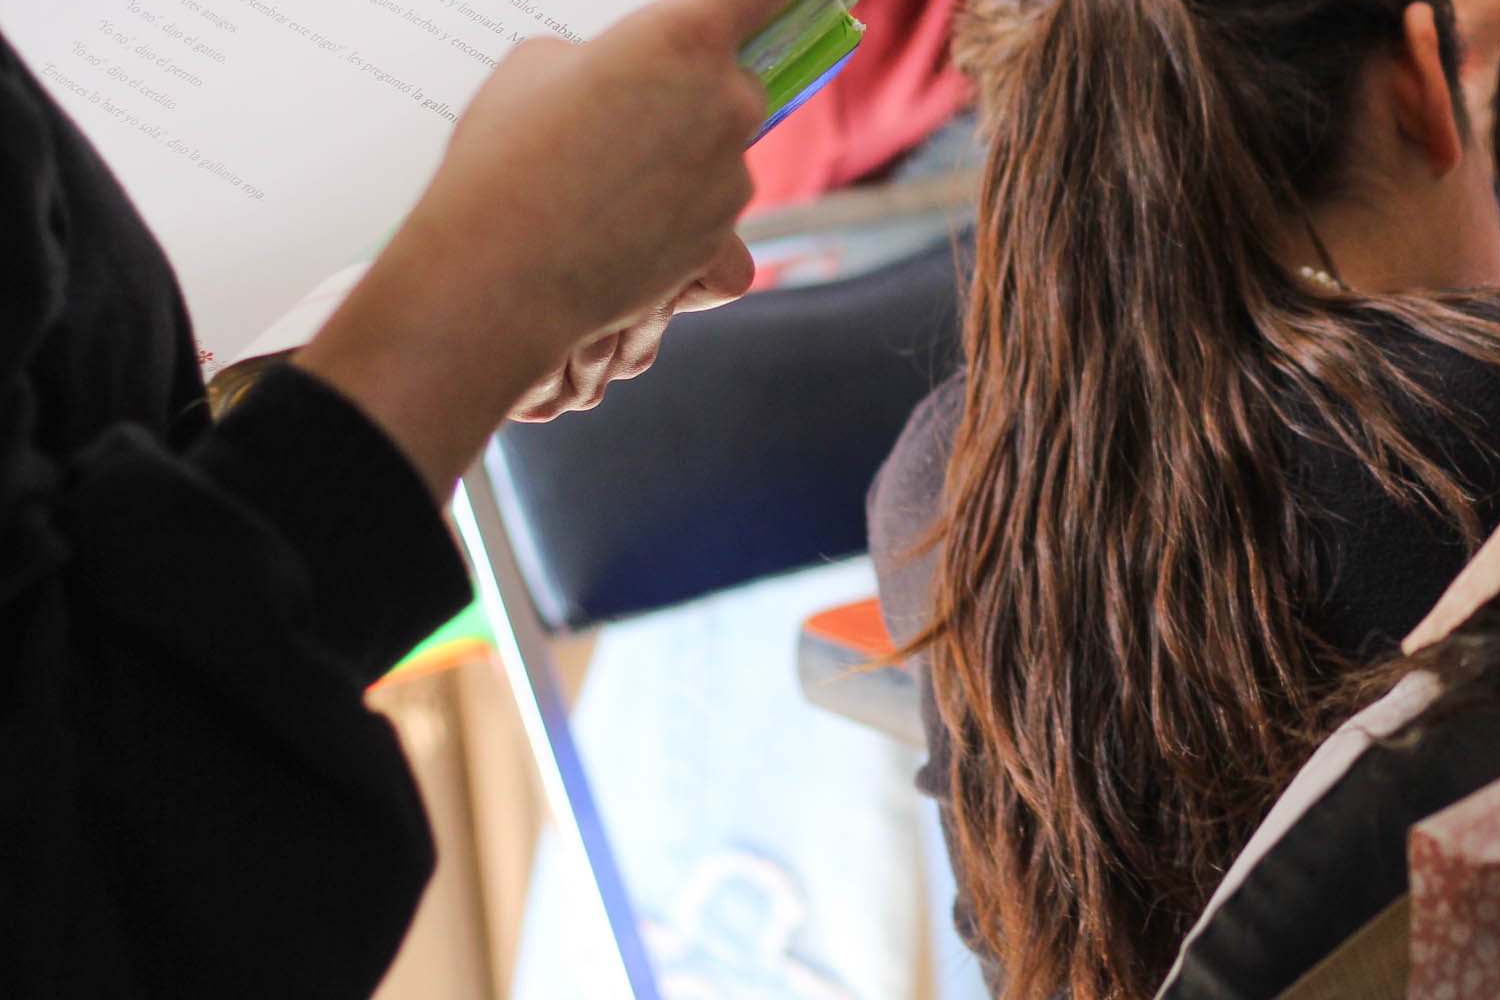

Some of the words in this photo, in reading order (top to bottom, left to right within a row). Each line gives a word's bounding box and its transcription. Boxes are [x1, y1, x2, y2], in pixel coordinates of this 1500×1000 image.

[161, 22, 184, 39] dijo
[402, 8, 442, 36] hierbas
[133, 43, 157, 61] dijo
[288, 21, 311, 36] este
[346, 51, 364, 66] les
[361, 63, 414, 94] preguntó
[105, 65, 129, 83] dijo
[100, 98, 125, 117] haré
[165, 138, 190, 156] dijo
[197, 159, 244, 187] gallinita
